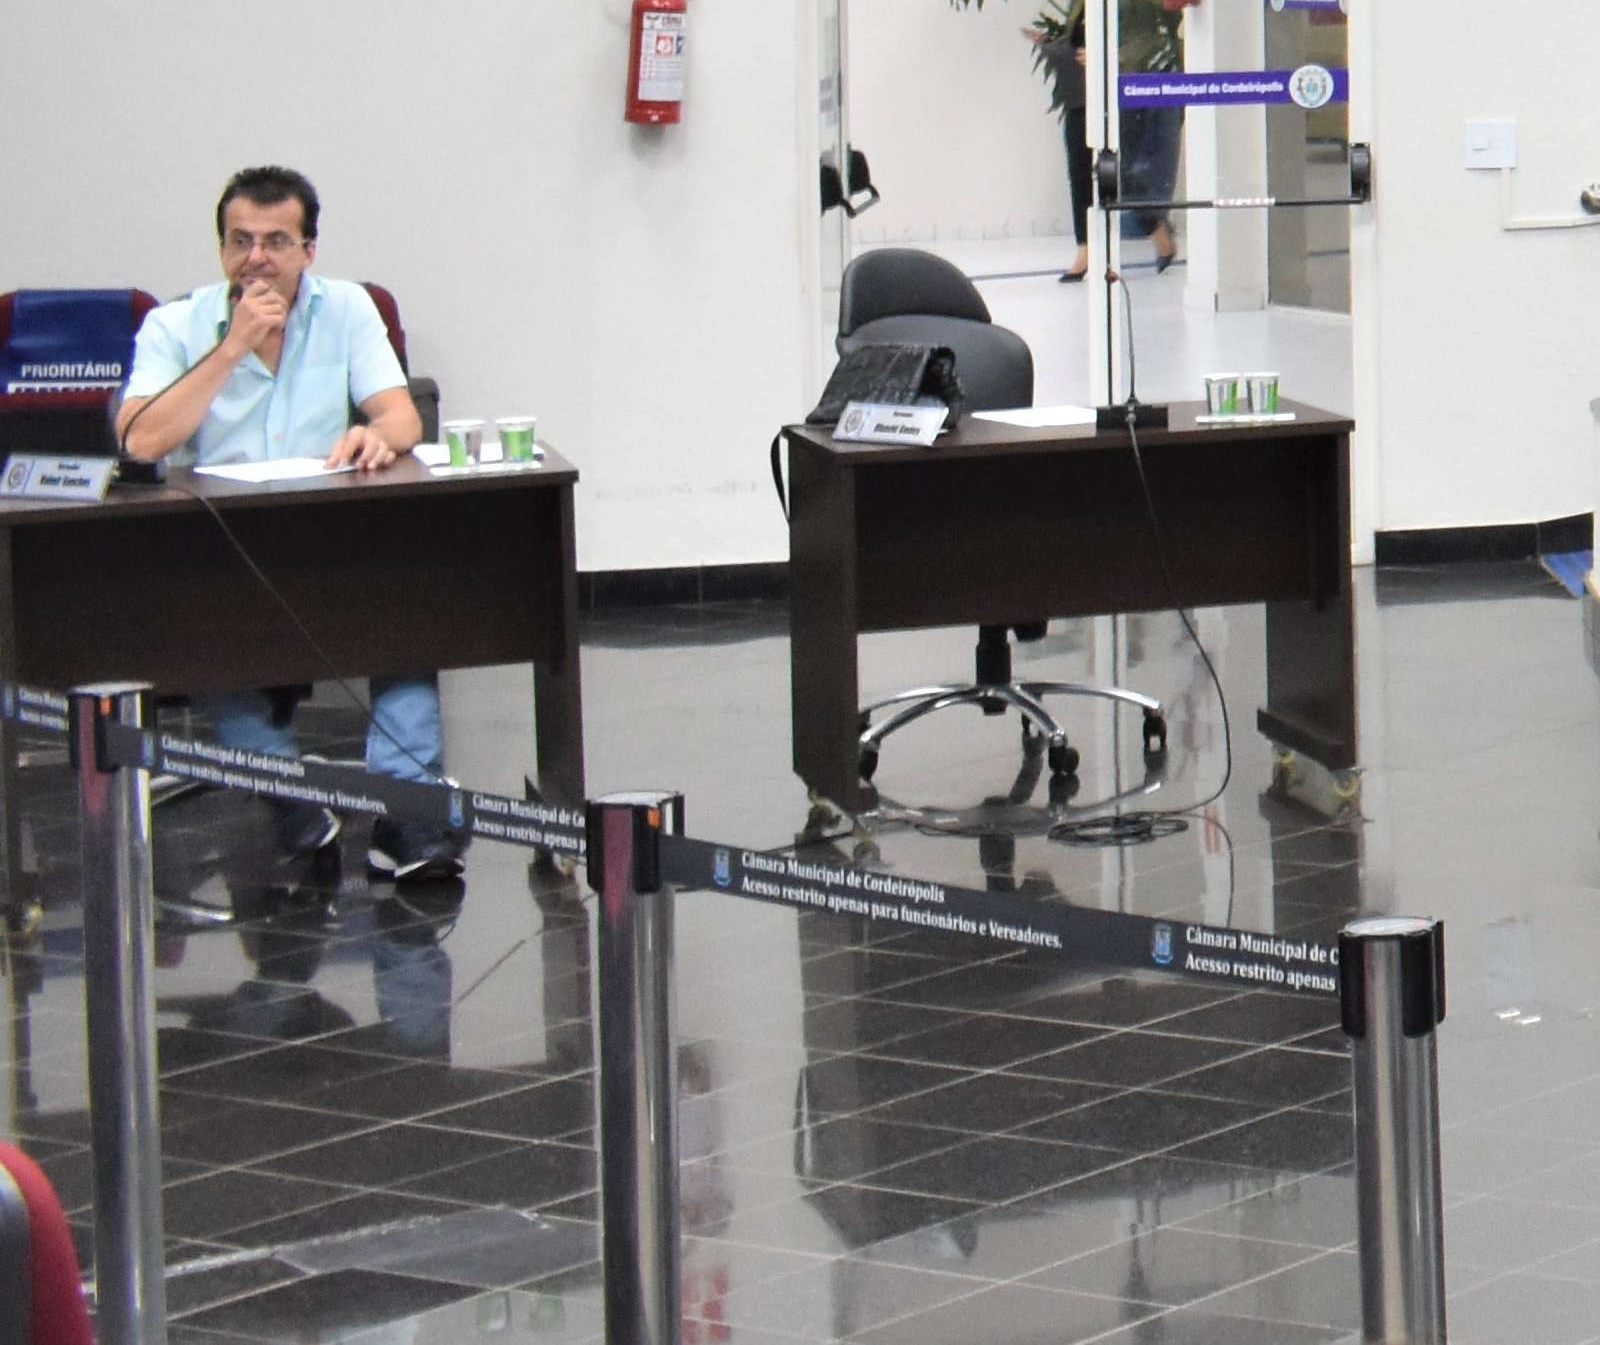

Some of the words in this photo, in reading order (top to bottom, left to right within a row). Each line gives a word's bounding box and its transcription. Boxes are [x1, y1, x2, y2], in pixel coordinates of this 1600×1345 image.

[1124, 84, 1160, 96] Câmara
[1162, 84, 1207, 97] Municipal
[1208, 83, 1220, 94] de
[1221, 82, 1283, 95] Cordeirópolis
[21, 361, 122, 378] PRIORITÁRIO
[162, 733, 193, 754] Câmara
[194, 741, 235, 765] Municipal
[235, 750, 246, 766] de
[247, 752, 305, 778] Cordeirópolis
[162, 756, 191, 776] Acesso
[192, 763, 223, 782] restrito
[224, 770, 254, 789] apenas
[255, 776, 274, 792] para
[275, 779, 328, 802] funcionários
[473, 794, 508, 814] Câmara
[510, 800, 557, 825] Municipal
[558, 808, 571, 826] de
[473, 815, 505, 835] Acesso
[506, 824, 542, 843] restrito
[543, 832, 578, 849] apenas
[741, 851, 785, 873] Câmara
[787, 859, 844, 887] Municipal
[847, 870, 861, 888] de
[863, 873, 945, 903] Cordeirópolis
[741, 876, 781, 897] Acesso
[782, 885, 826, 906] restrito
[828, 894, 870, 915] apenas
[871, 903, 898, 920] para
[901, 905, 977, 935] funcionários
[978, 923, 987, 936] e
[988, 920, 1063, 949] Vereadores.
[1186, 926, 1237, 949] Câmara
[1239, 933, 1307, 963] Municipal
[1309, 943, 1327, 963] de
[1185, 953, 1231, 975] Acesso
[1233, 963, 1285, 984] restrito
[1286, 972, 1336, 992] apenas
